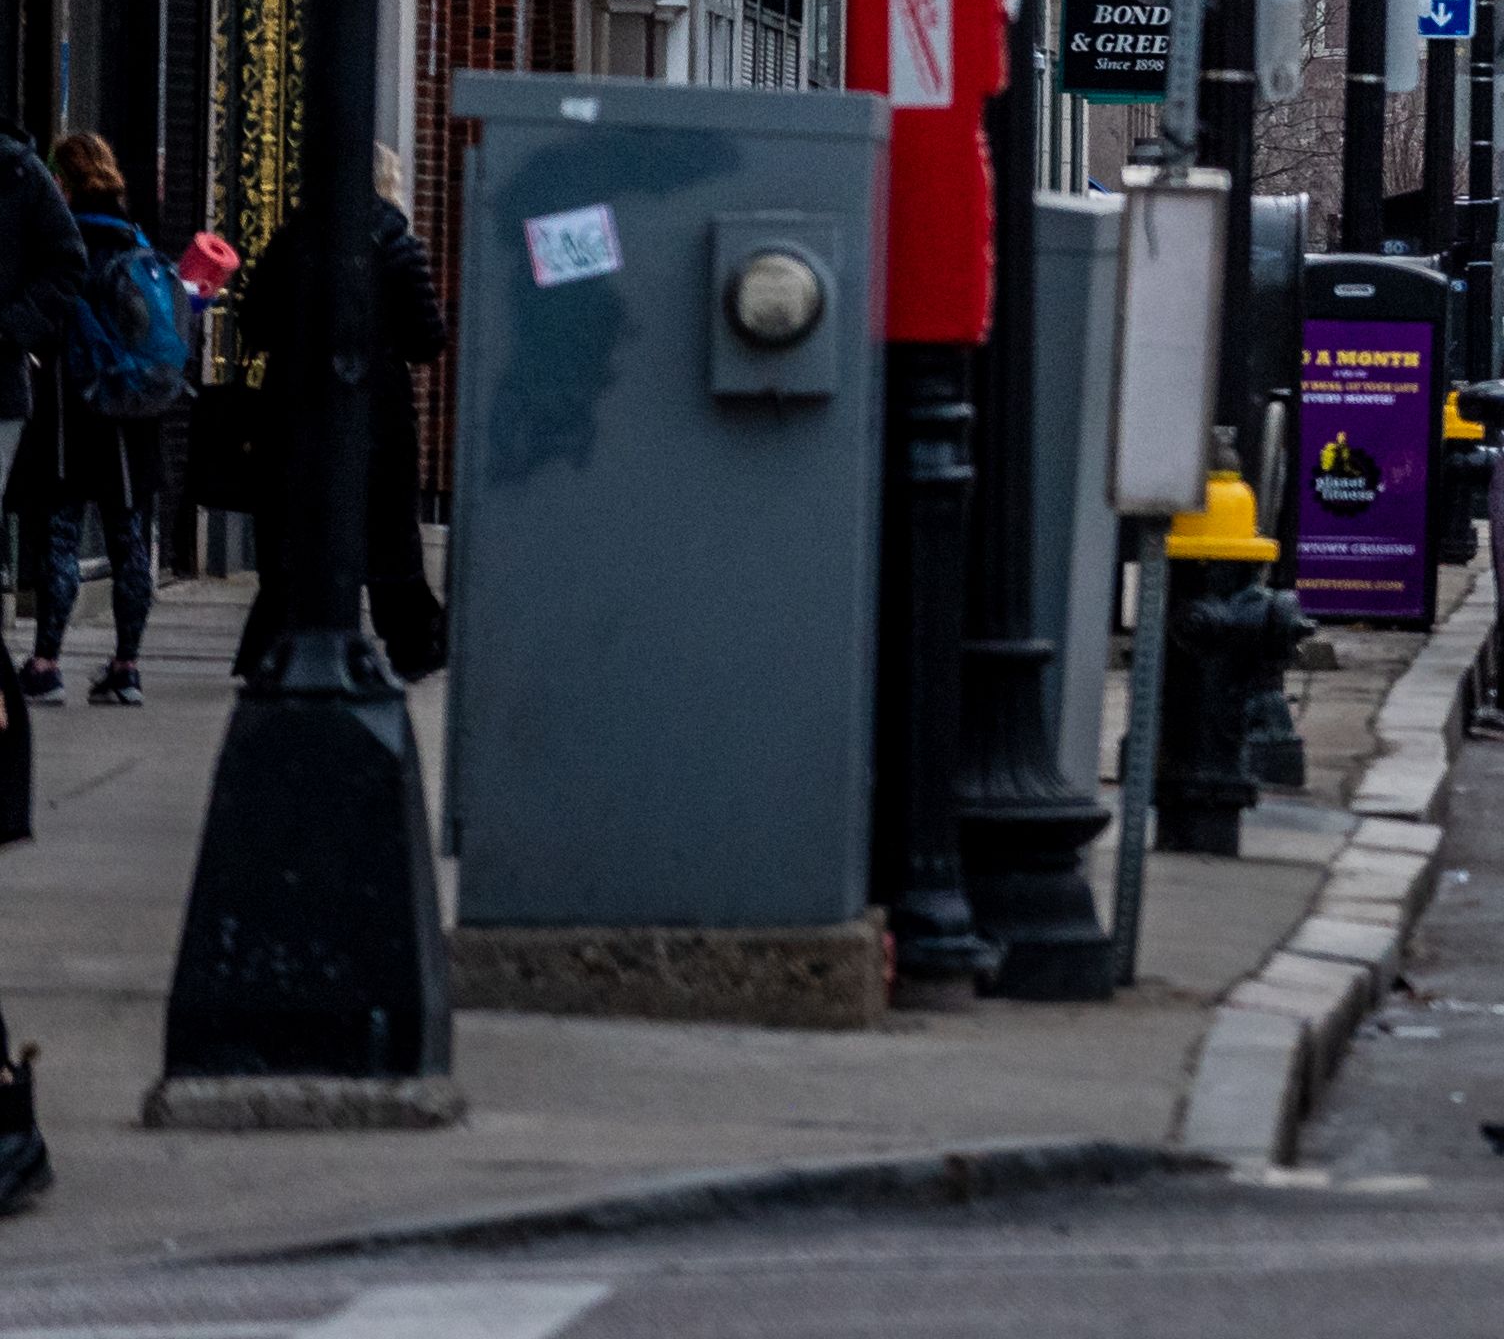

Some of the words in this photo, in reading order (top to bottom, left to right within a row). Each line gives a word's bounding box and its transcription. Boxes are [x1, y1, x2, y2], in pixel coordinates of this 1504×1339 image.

[1092, 4, 1172, 26] BOND
[1070, 32, 1091, 52] &
[1095, 33, 1170, 54] GREE
[1094, 57, 1131, 71] Since
[1134, 58, 1165, 71] 1898
[1315, 349, 1331, 366] A
[1335, 349, 1421, 368] MONTH
